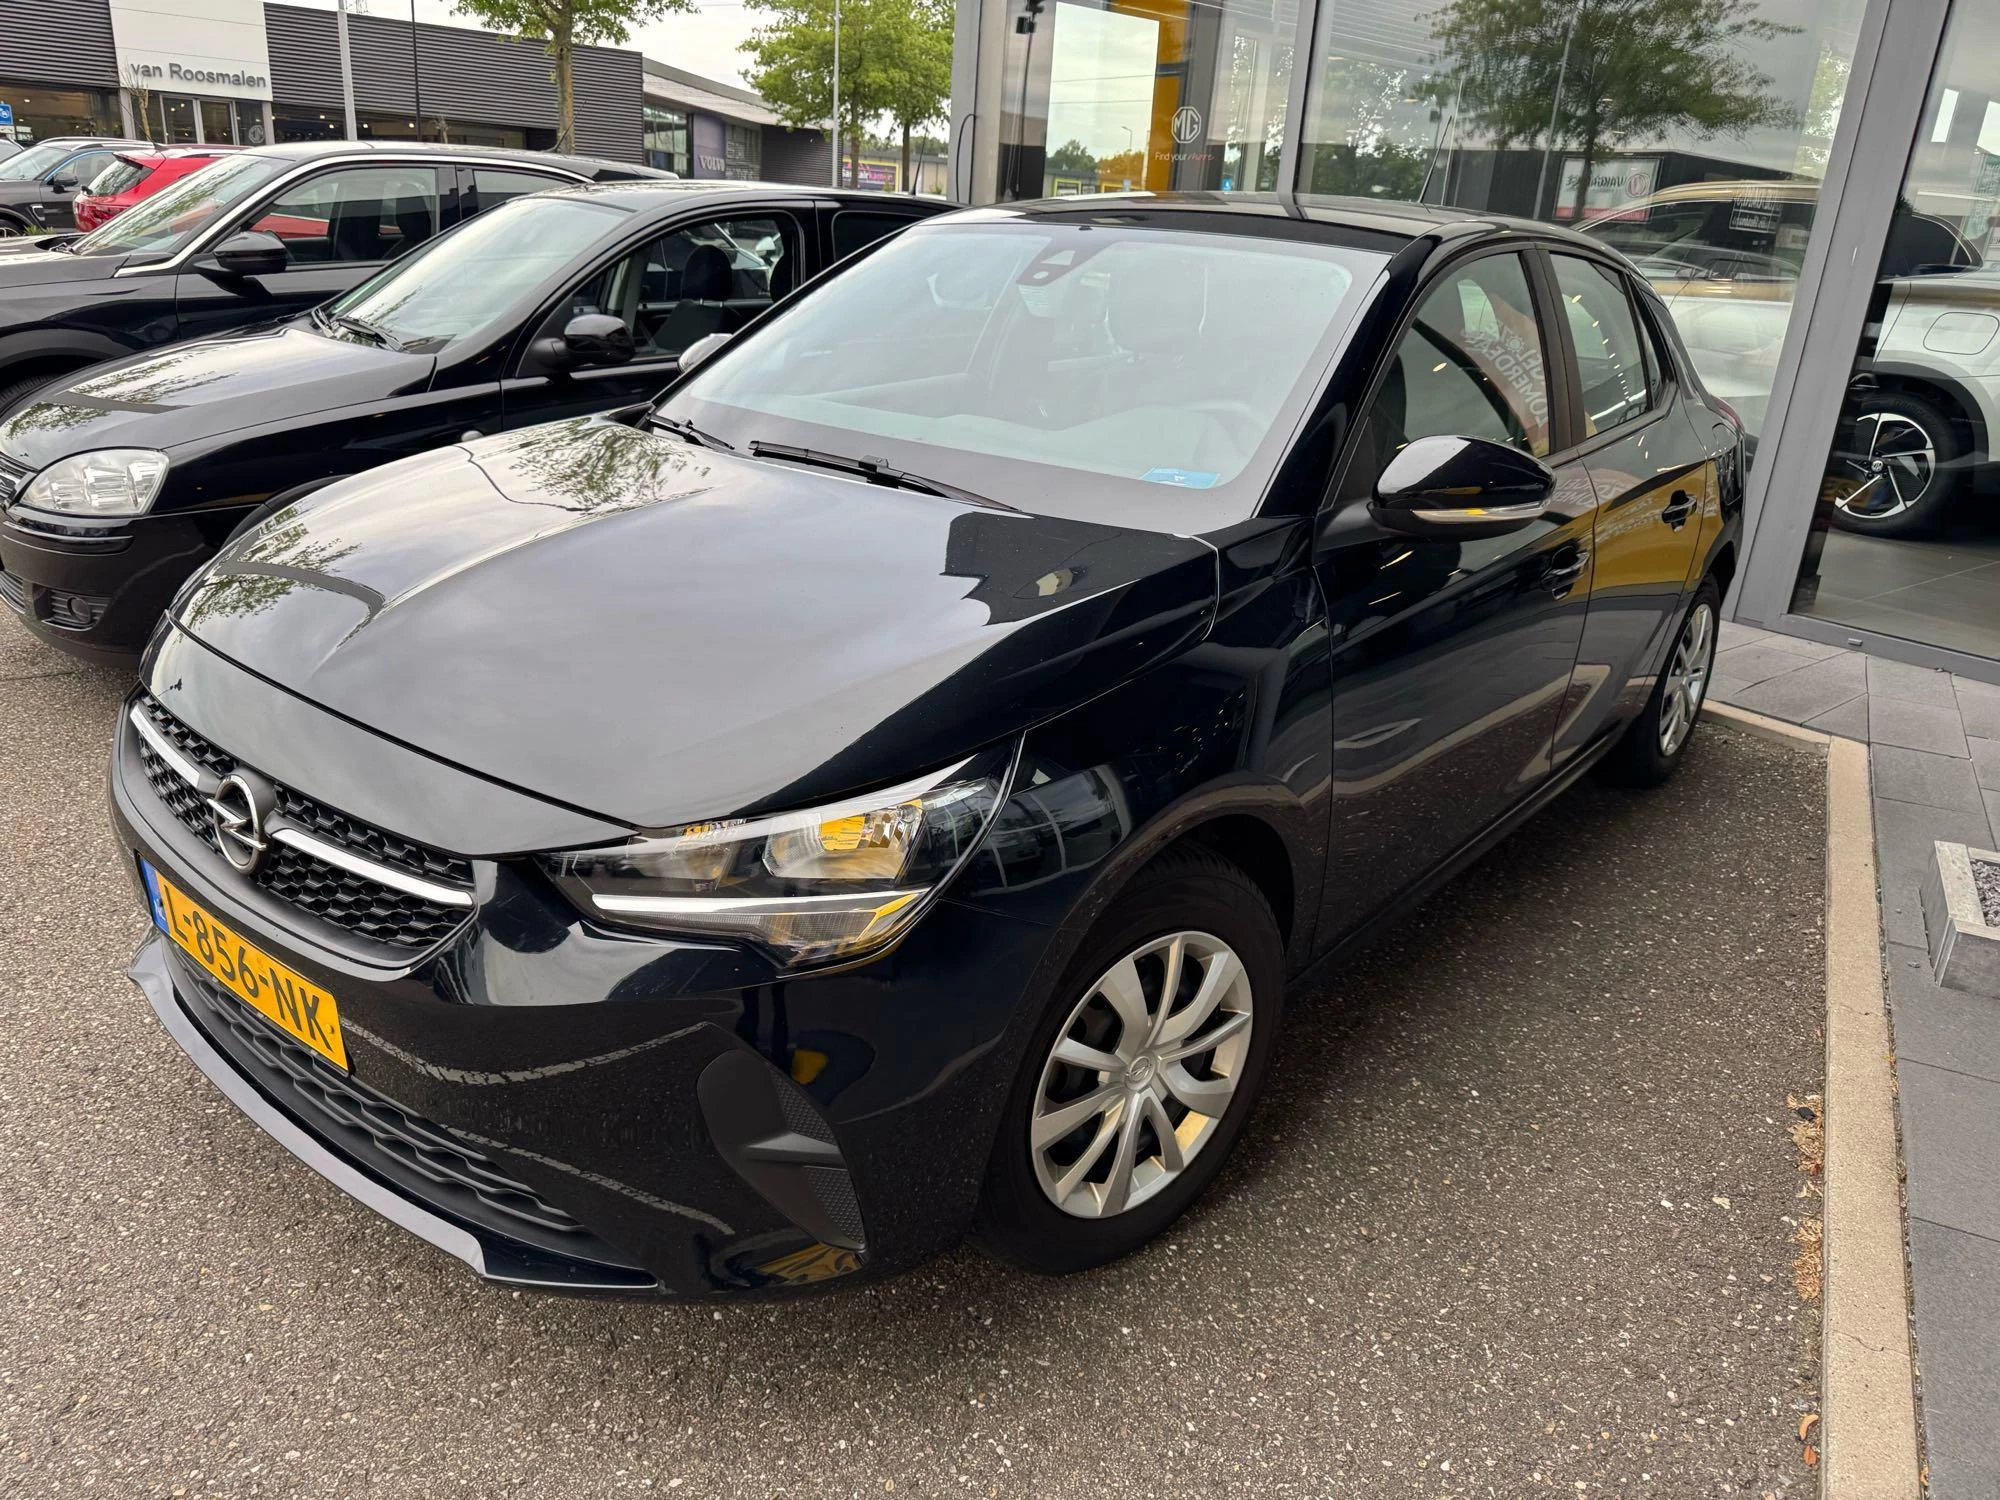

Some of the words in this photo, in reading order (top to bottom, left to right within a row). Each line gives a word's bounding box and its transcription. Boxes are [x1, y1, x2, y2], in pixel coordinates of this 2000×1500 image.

[131, 63, 162, 78] van
[169, 62, 267, 88] Roosmalen
[1173, 108, 1200, 142] MG
[699, 153, 726, 172] VOLVO
[1154, 151, 1170, 160] Find
[1171, 152, 1187, 162] your
[163, 884, 334, 1053] L-856-NK
